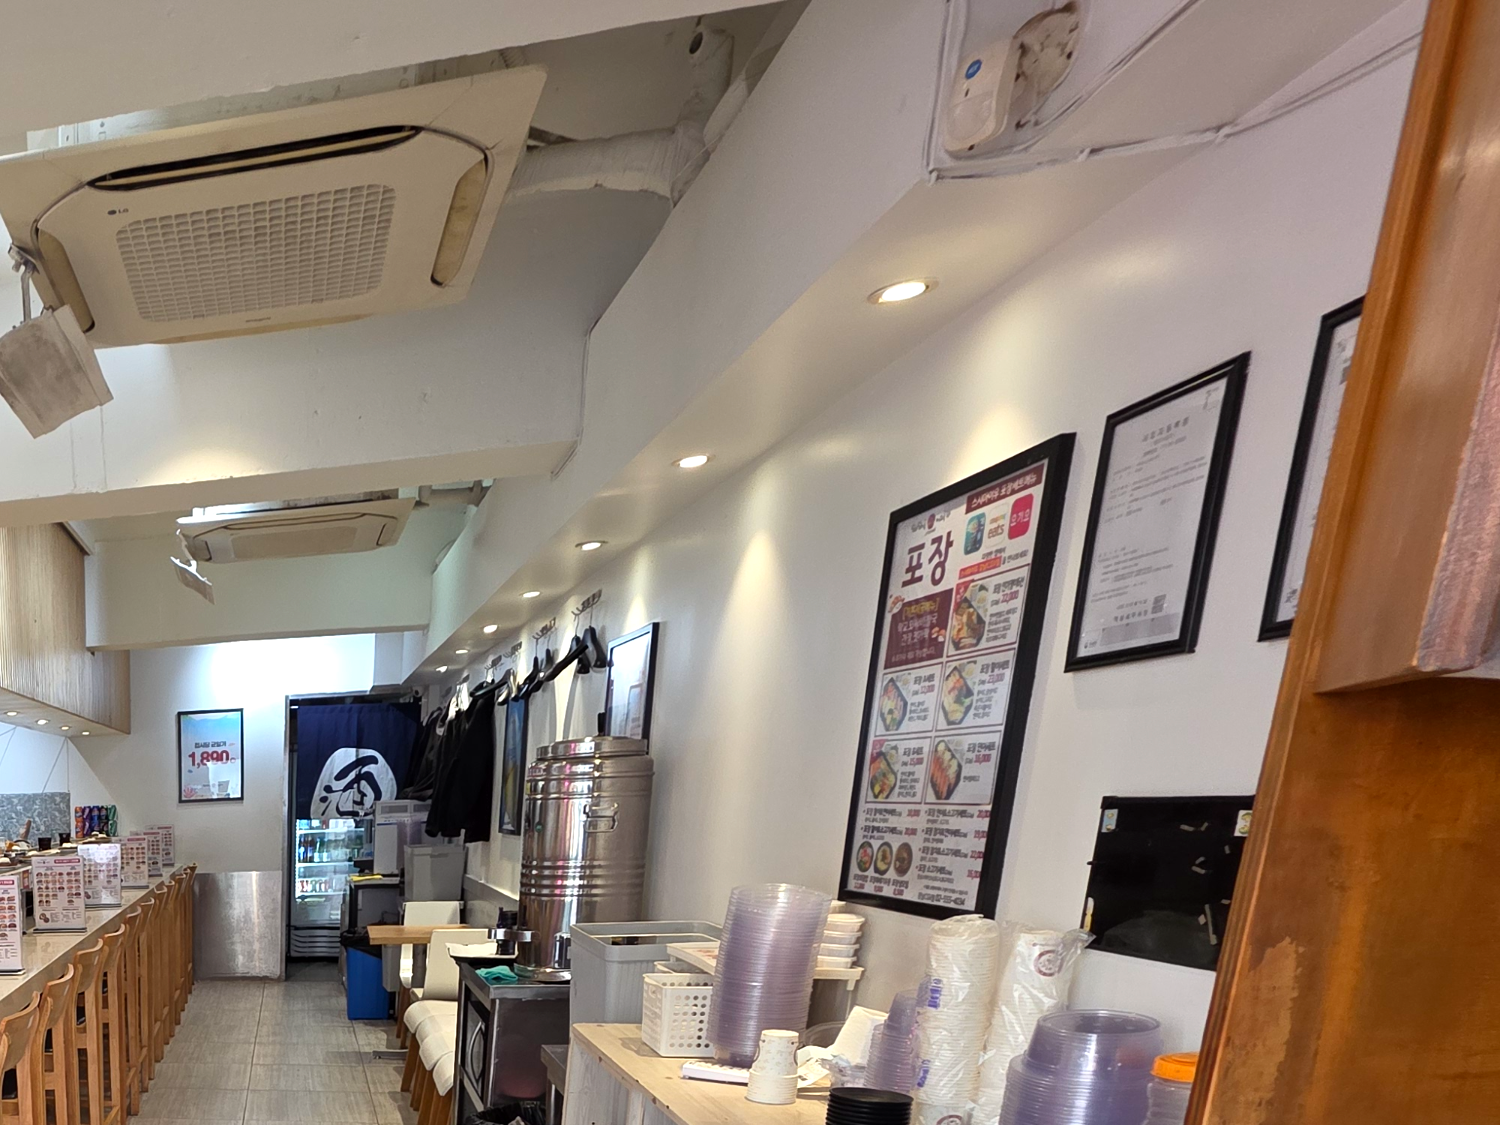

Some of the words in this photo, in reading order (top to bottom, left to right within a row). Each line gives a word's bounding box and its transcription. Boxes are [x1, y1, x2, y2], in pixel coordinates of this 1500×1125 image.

[1010, 508, 1031, 527] 요기요
[987, 524, 1005, 539] eats
[901, 530, 954, 588] 포장
[188, 750, 230, 769] 1,890
